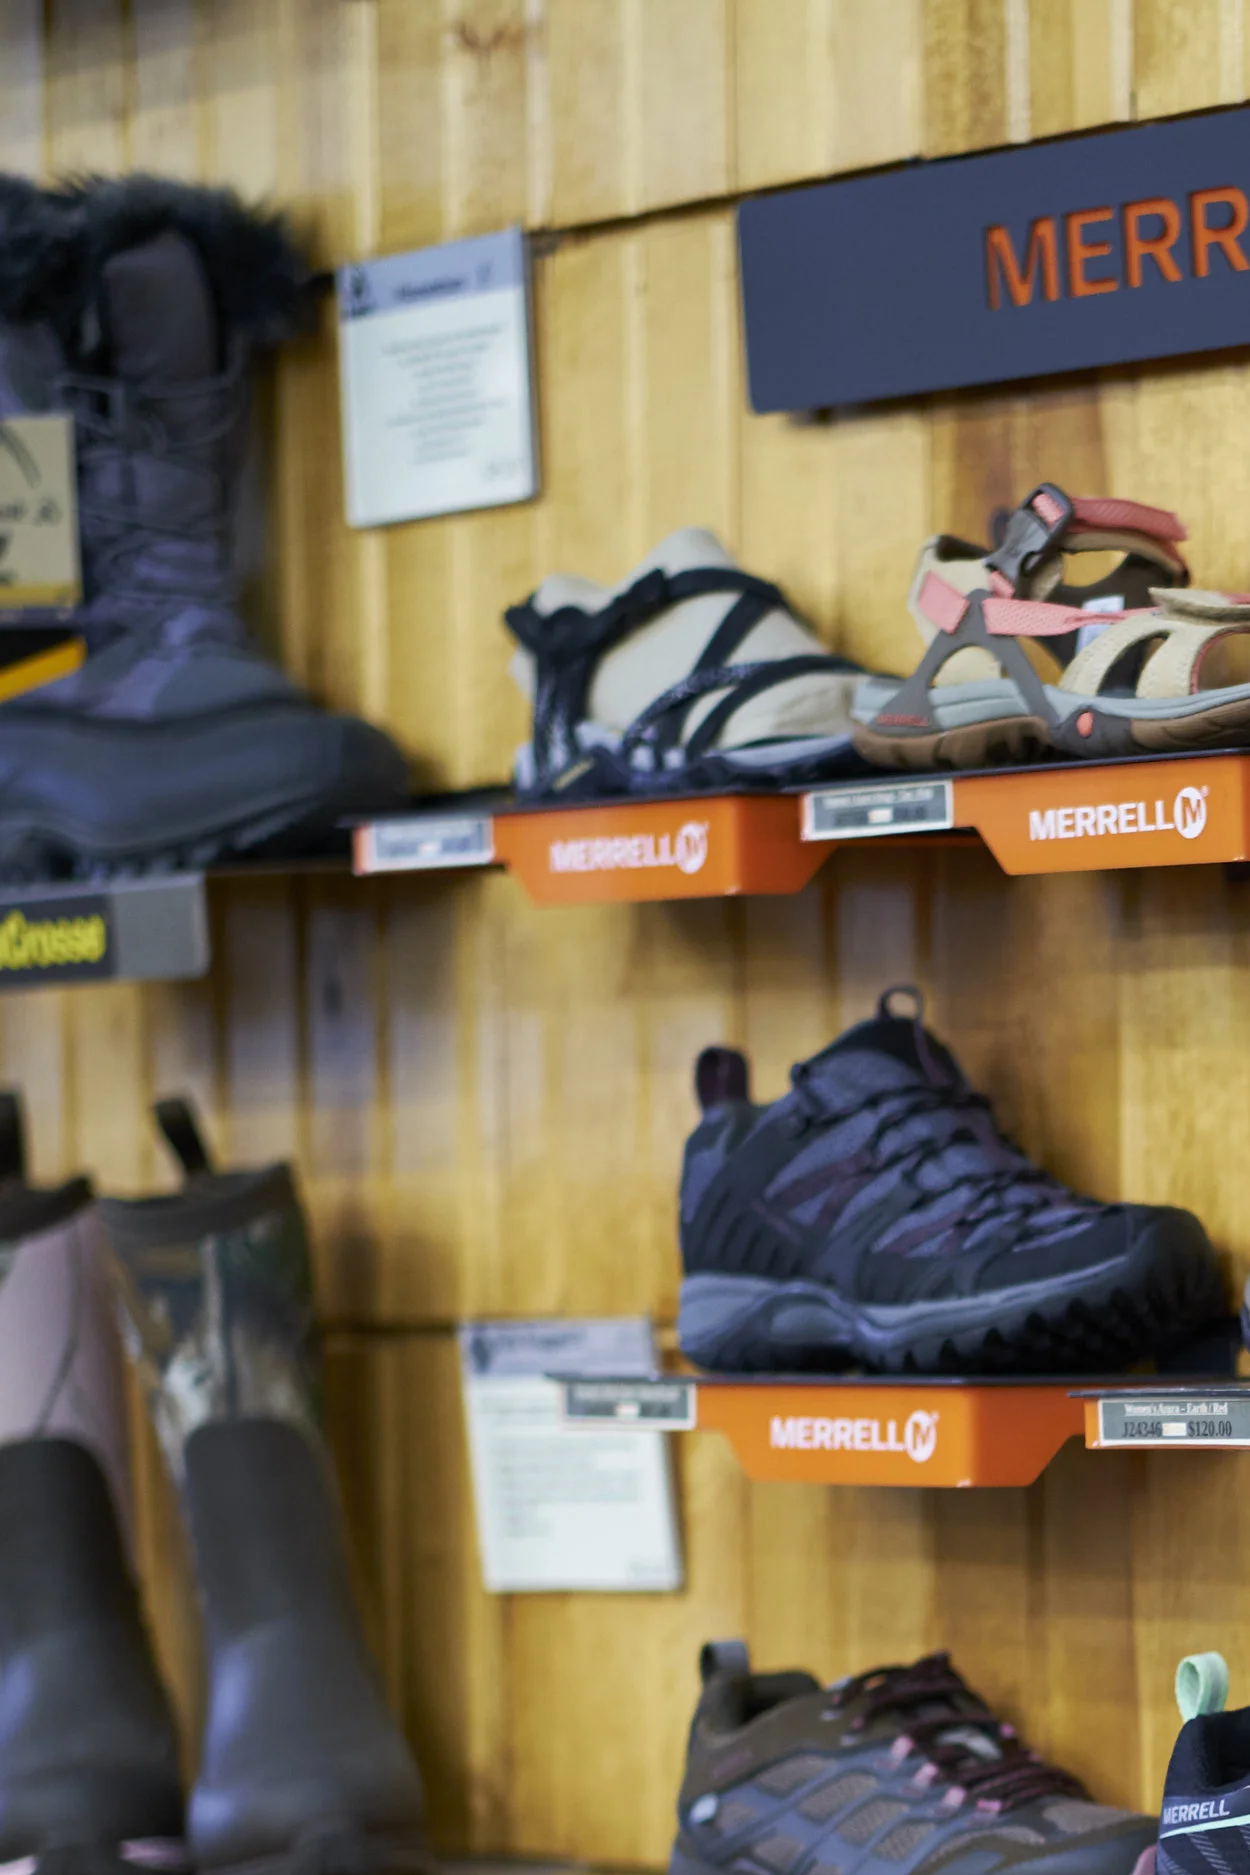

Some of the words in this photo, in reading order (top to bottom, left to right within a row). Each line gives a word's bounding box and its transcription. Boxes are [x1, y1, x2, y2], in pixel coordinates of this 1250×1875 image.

[1029, 801, 1175, 841] MERRELL
[550, 833, 676, 874] MERRELL
[770, 1416, 905, 1451] MERRELL
[1187, 1420, 1232, 1437] $120.00
[1163, 1799, 1230, 1825] MERRELL
